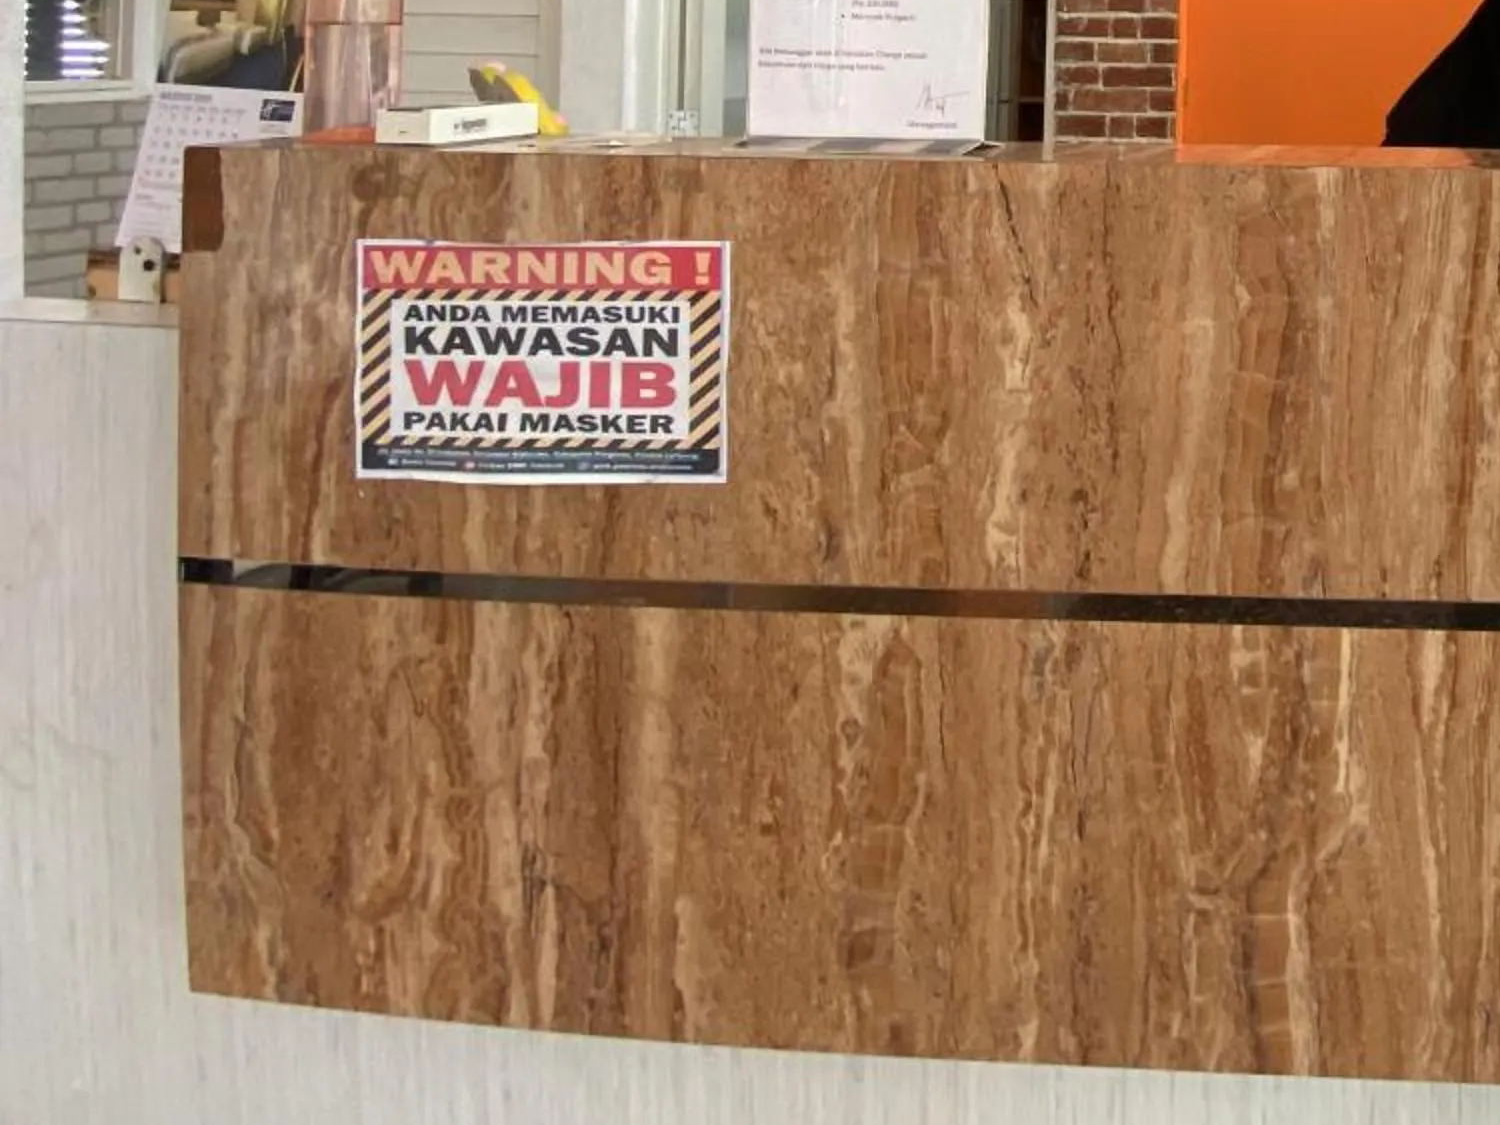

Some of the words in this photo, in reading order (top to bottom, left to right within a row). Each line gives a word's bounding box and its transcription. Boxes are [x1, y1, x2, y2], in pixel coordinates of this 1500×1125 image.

[369, 250, 672, 286] WARNING
[694, 251, 711, 286] !
[403, 304, 491, 323] ANDA
[501, 305, 681, 324] MEMASUKI
[403, 326, 679, 357] KAWASAN
[403, 359, 678, 409] WAJIB
[402, 411, 507, 433] PAKAI
[519, 412, 674, 434] MASKER
